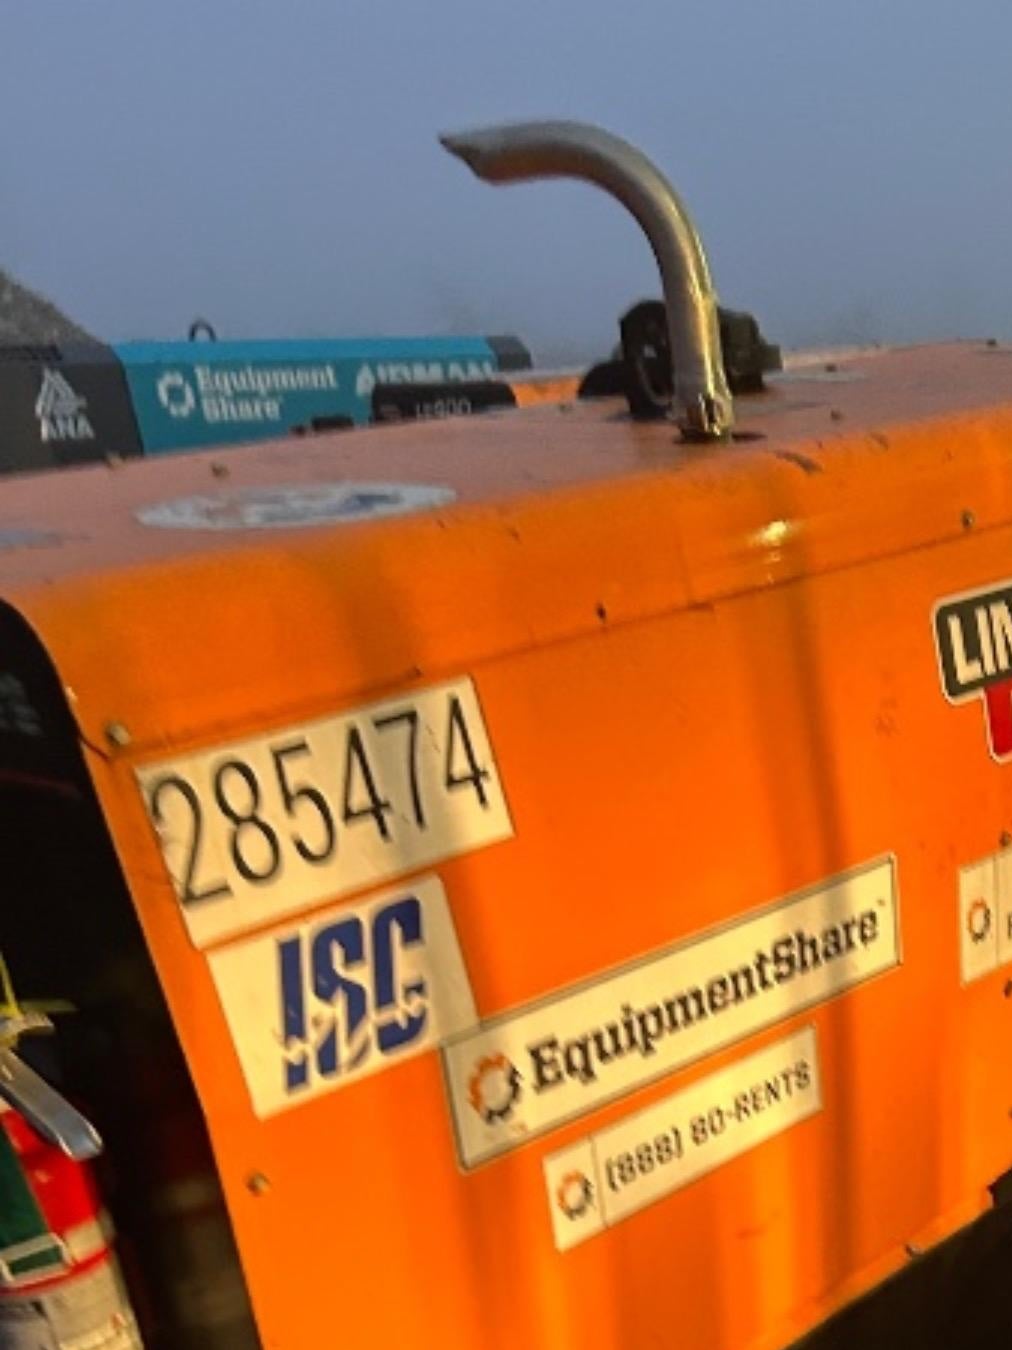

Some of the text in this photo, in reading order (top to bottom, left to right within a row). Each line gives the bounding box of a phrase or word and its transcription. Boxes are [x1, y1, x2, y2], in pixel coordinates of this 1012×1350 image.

[194, 362, 338, 397] Equipment
[203, 397, 281, 423] Share
[150, 692, 490, 910] 285474
[526, 908, 879, 1095] EquipmentShare
[604, 1060, 812, 1193] (888) 80-RENTS
